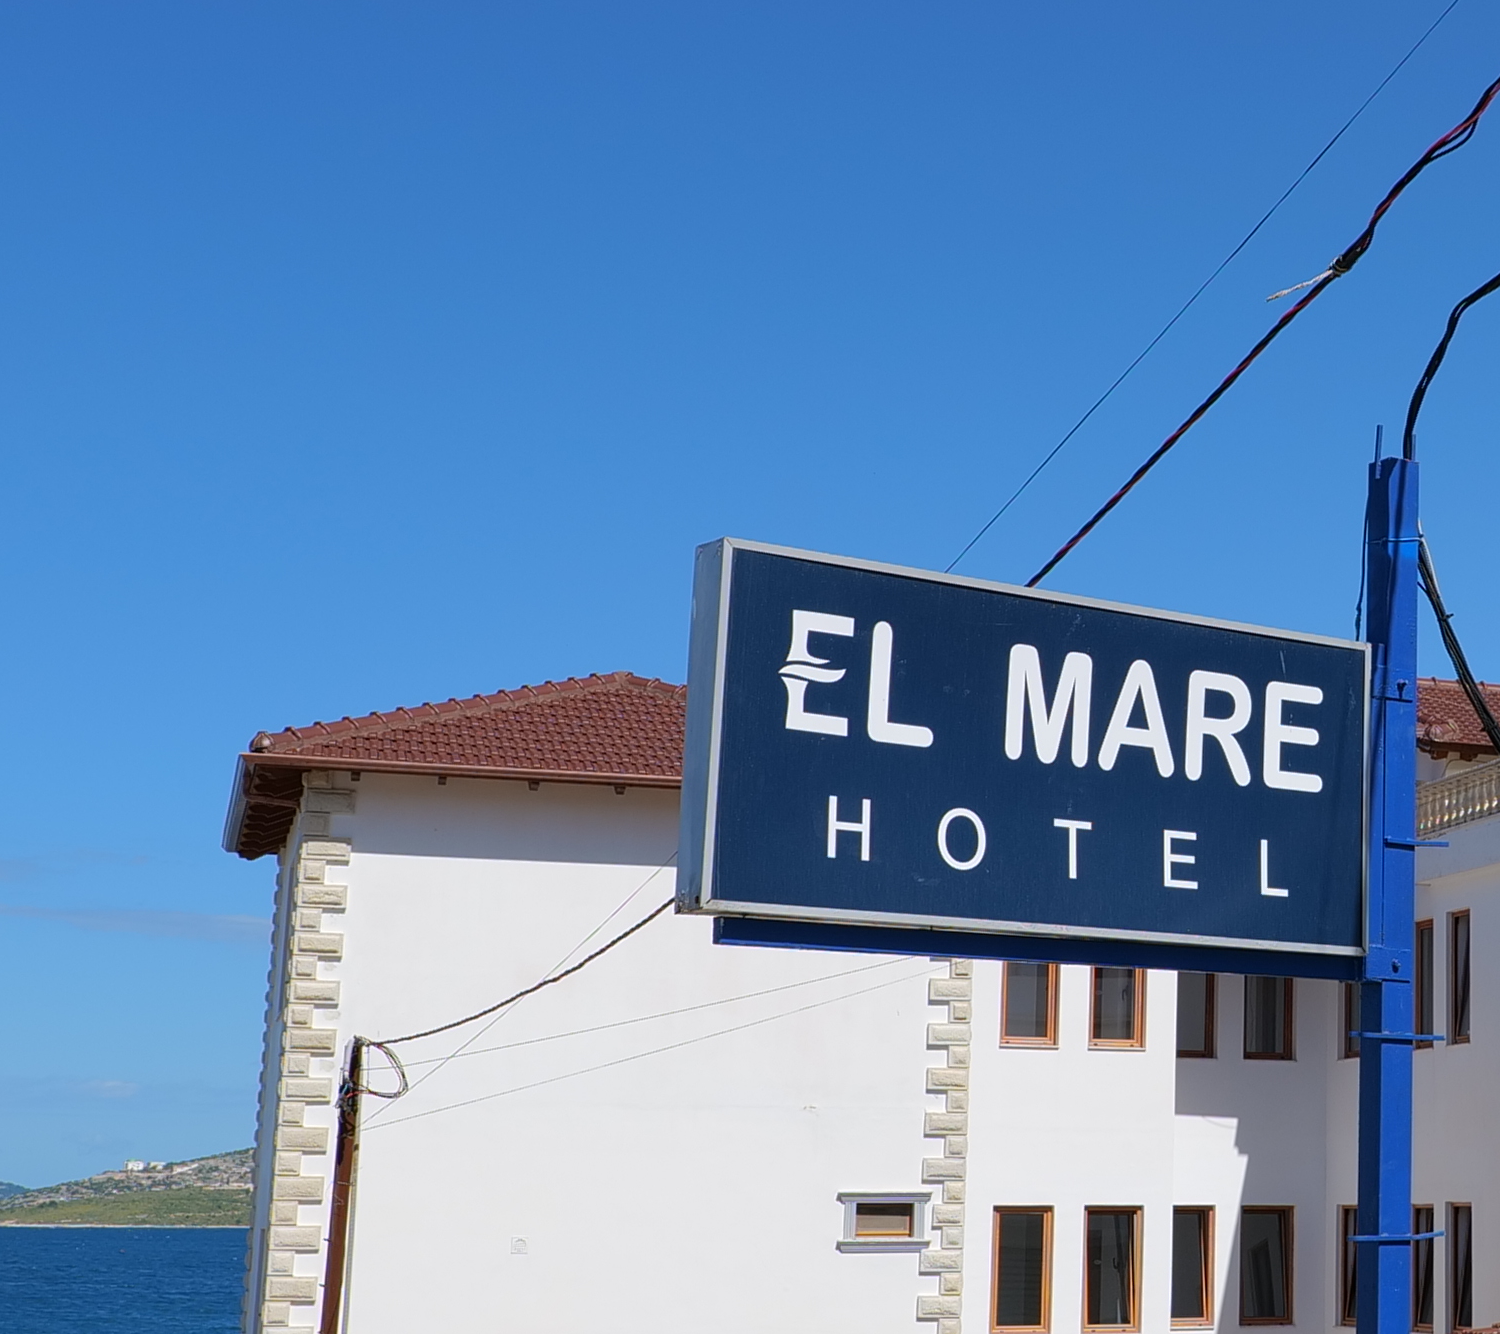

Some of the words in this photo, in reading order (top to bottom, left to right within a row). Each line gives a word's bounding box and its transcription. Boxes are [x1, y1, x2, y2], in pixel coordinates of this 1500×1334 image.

[778, 609, 934, 748] EL
[1004, 643, 1324, 793] MARE
[827, 795, 1289, 898] HOTEL
